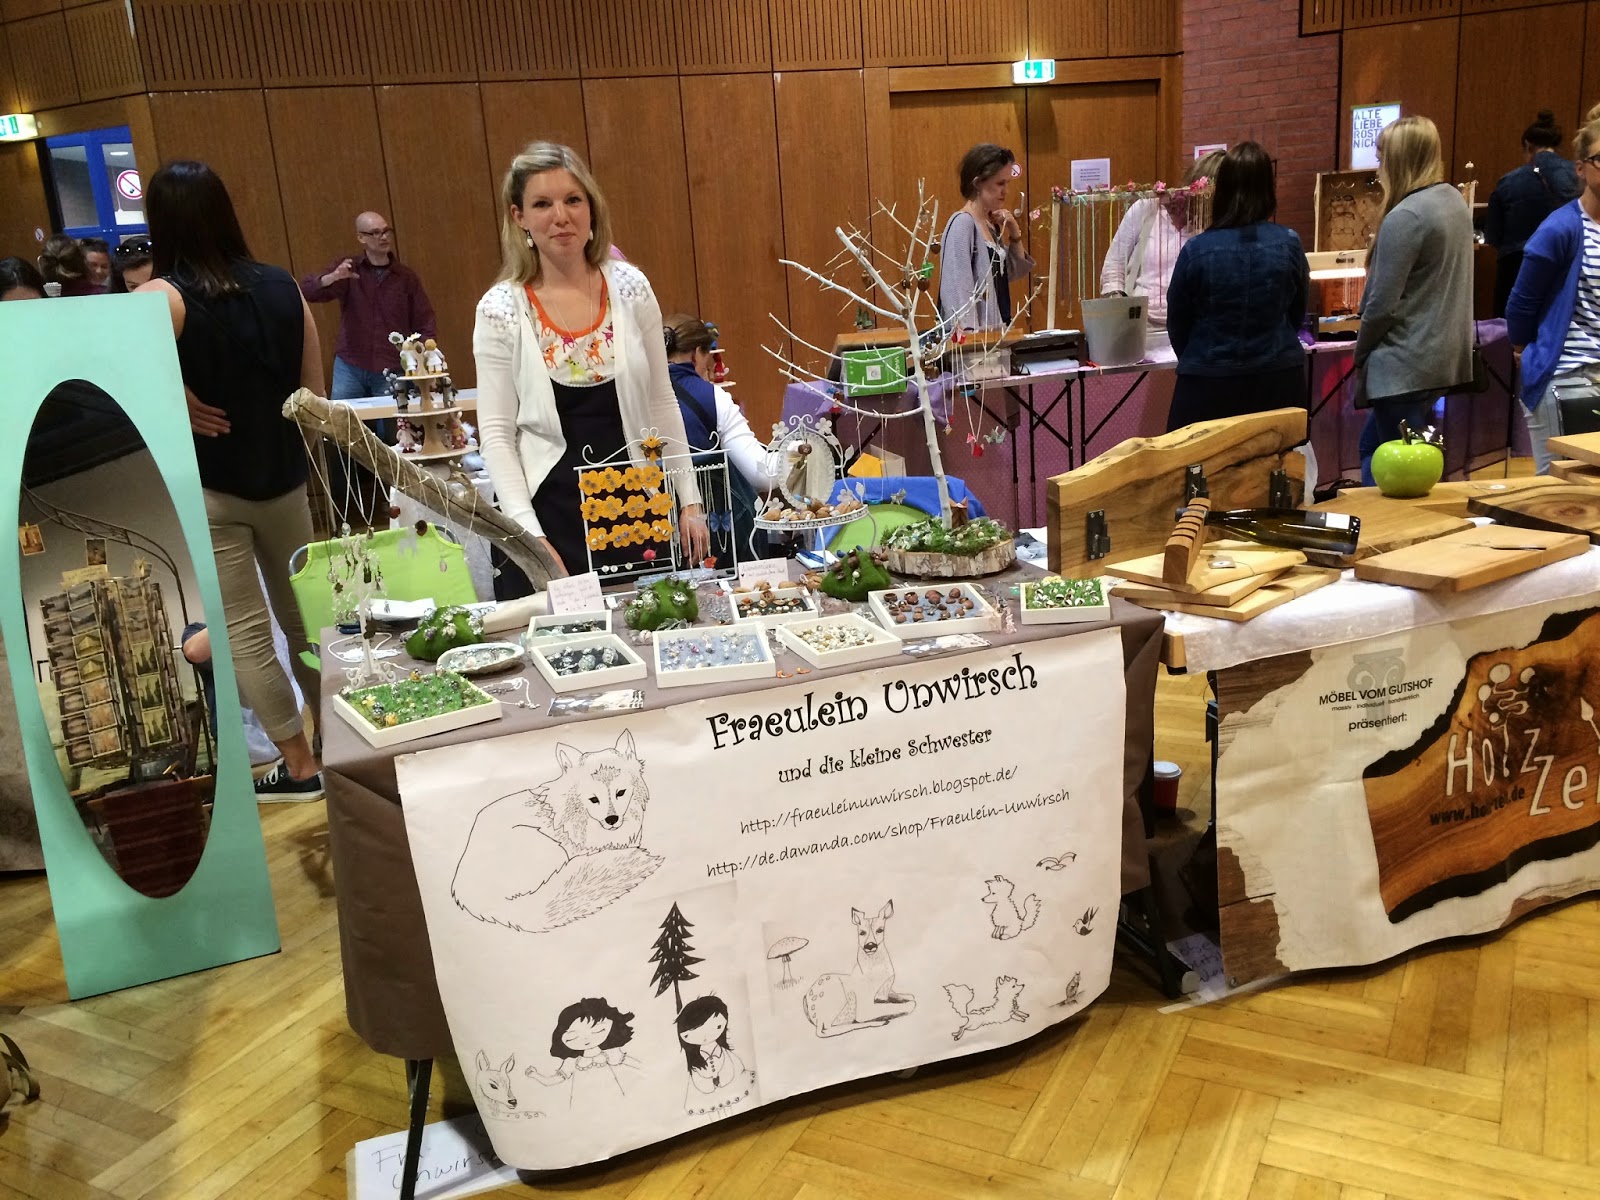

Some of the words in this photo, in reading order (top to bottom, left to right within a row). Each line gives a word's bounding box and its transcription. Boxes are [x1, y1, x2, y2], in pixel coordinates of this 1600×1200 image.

[1353, 119, 1382, 130] LIEBE
[1354, 109, 1381, 120] ALTE
[1353, 129, 1379, 139] ROST
[1353, 138, 1377, 149] NICH
[706, 691, 868, 750] Fraeulein
[882, 652, 1038, 713] Unwirsch
[1319, 690, 1358, 706] MÖBEL
[1358, 687, 1387, 700] VOM
[1388, 678, 1434, 696] GUTSHOF
[1348, 711, 1408, 732] präsentiert:
[778, 758, 812, 783] und
[819, 755, 844, 775] die
[850, 747, 901, 769] kleine
[907, 729, 992, 757] Schwester
[740, 765, 1018, 835] http://fraeuleinunwirsch.blogspot.de/
[706, 788, 1070, 877] http://de.dawanda.com/shop/Fraeulein-Unwirsch
